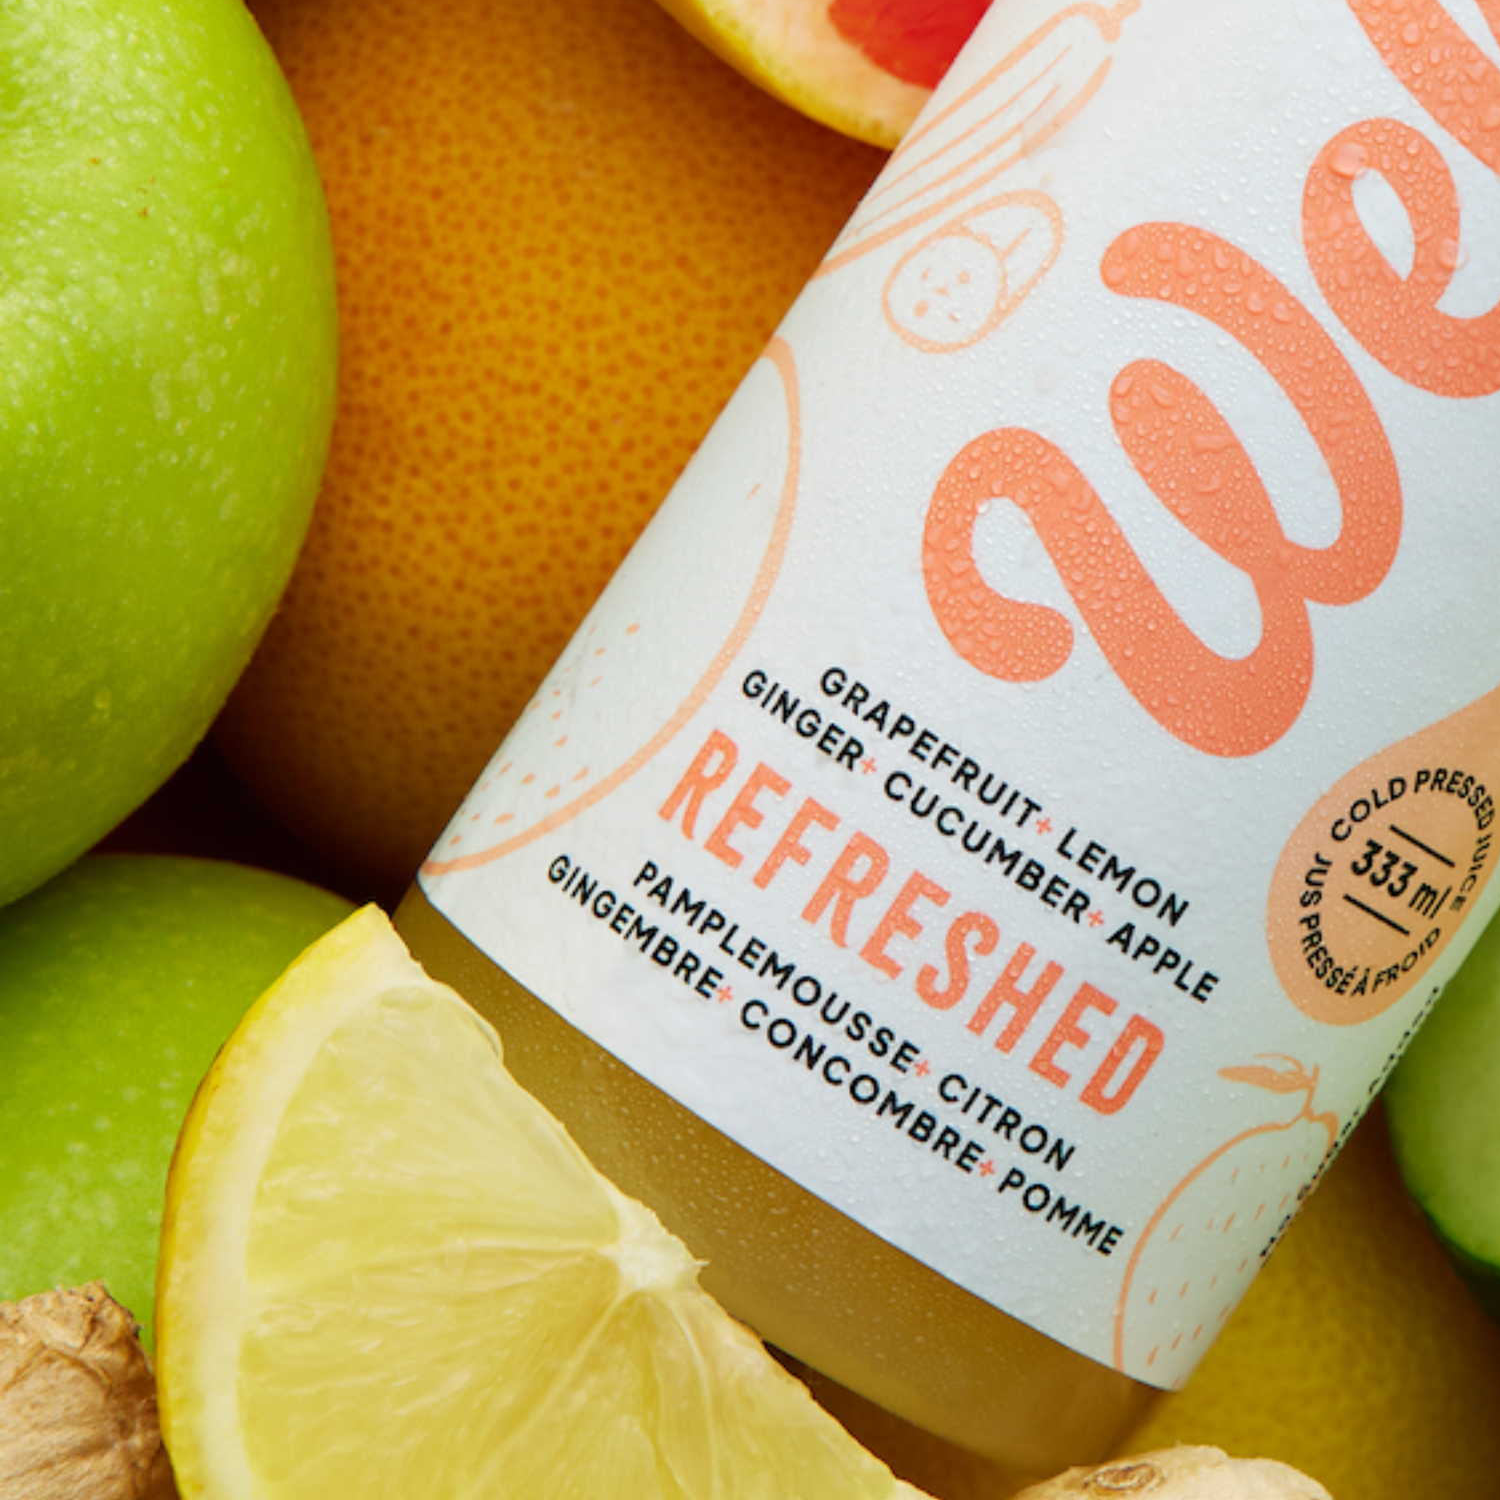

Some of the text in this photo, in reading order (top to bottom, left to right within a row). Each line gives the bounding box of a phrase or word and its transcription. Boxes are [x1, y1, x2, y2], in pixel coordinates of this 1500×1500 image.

[1056, 826, 1190, 928] LEMON
[1298, 851, 1334, 908] JUS
[1330, 767, 1496, 912] COLD PRESSED JUICE
[1350, 838, 1454, 919] 333 ml
[657, 728, 1166, 1117] REFRESHED
[1106, 921, 1220, 1003] APPLE
[1298, 911, 1359, 997] PRESSÉ
[1371, 926, 1442, 994] FROID
[937, 1072, 1076, 1172] CITRON
[997, 1166, 1125, 1257] POMME
